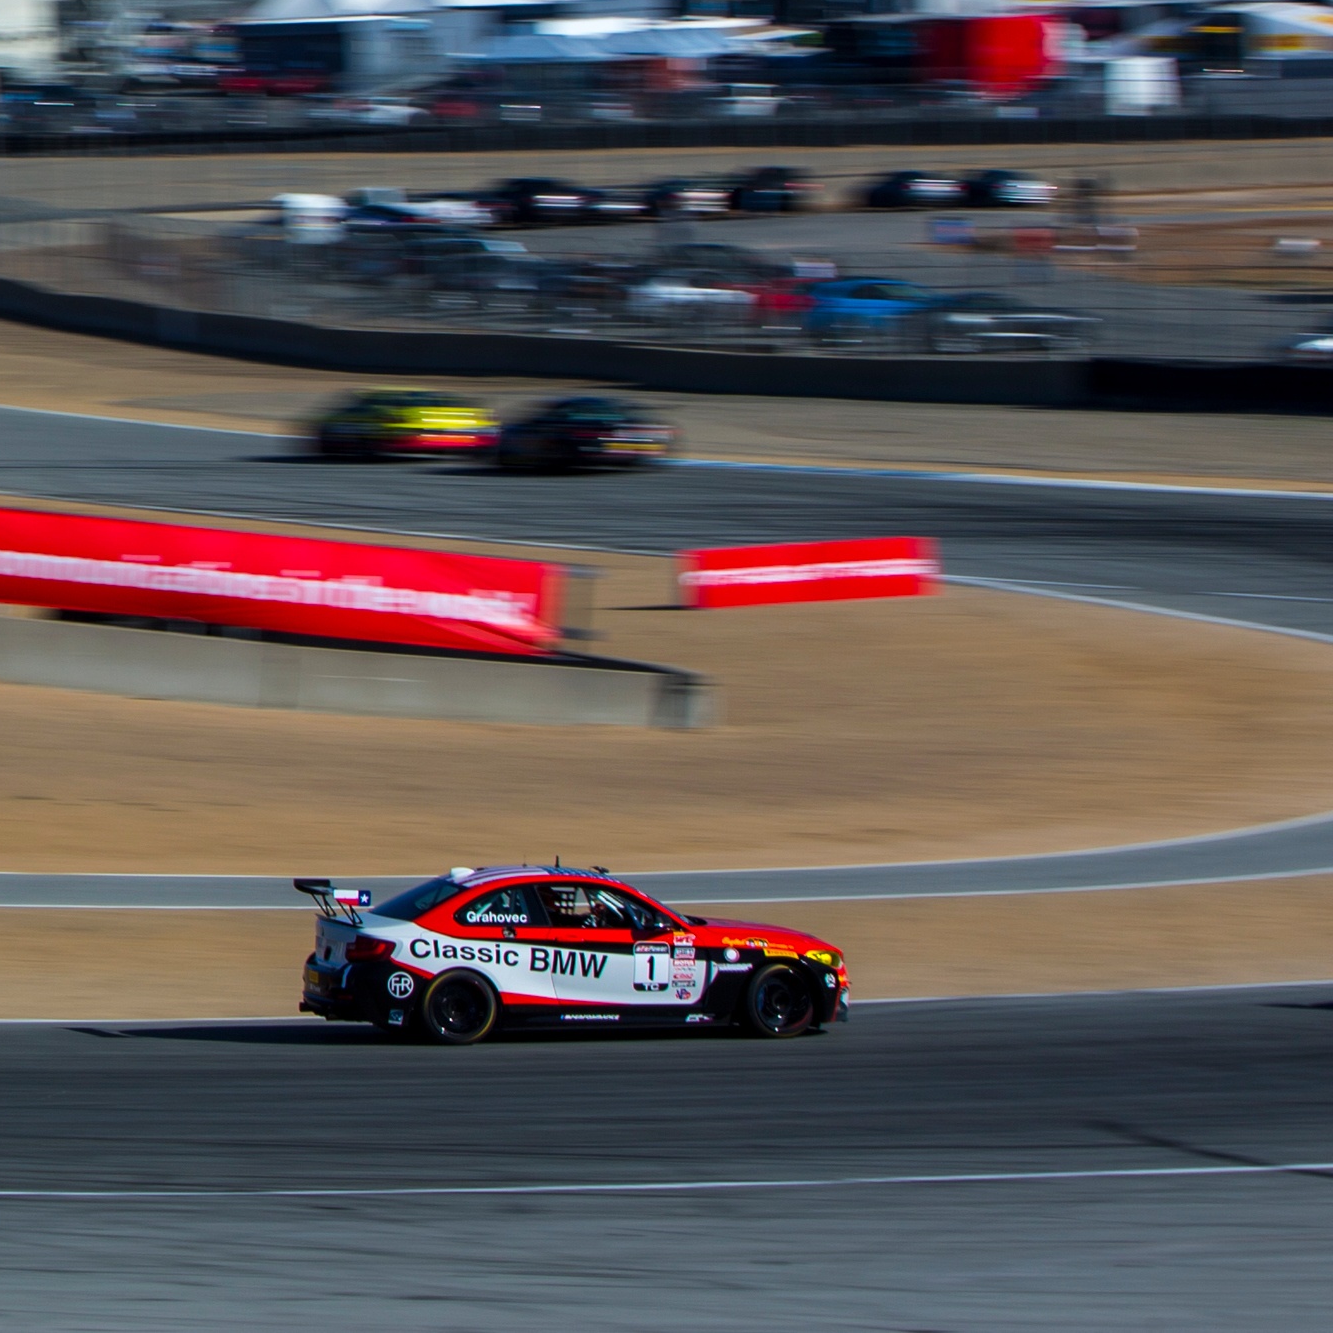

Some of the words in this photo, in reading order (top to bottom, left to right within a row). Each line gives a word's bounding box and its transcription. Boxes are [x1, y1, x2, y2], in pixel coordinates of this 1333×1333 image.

[467, 911, 527, 923] Grahovec
[409, 939, 519, 967] Classic
[529, 946, 608, 979] BMW
[647, 955, 656, 981] 1
